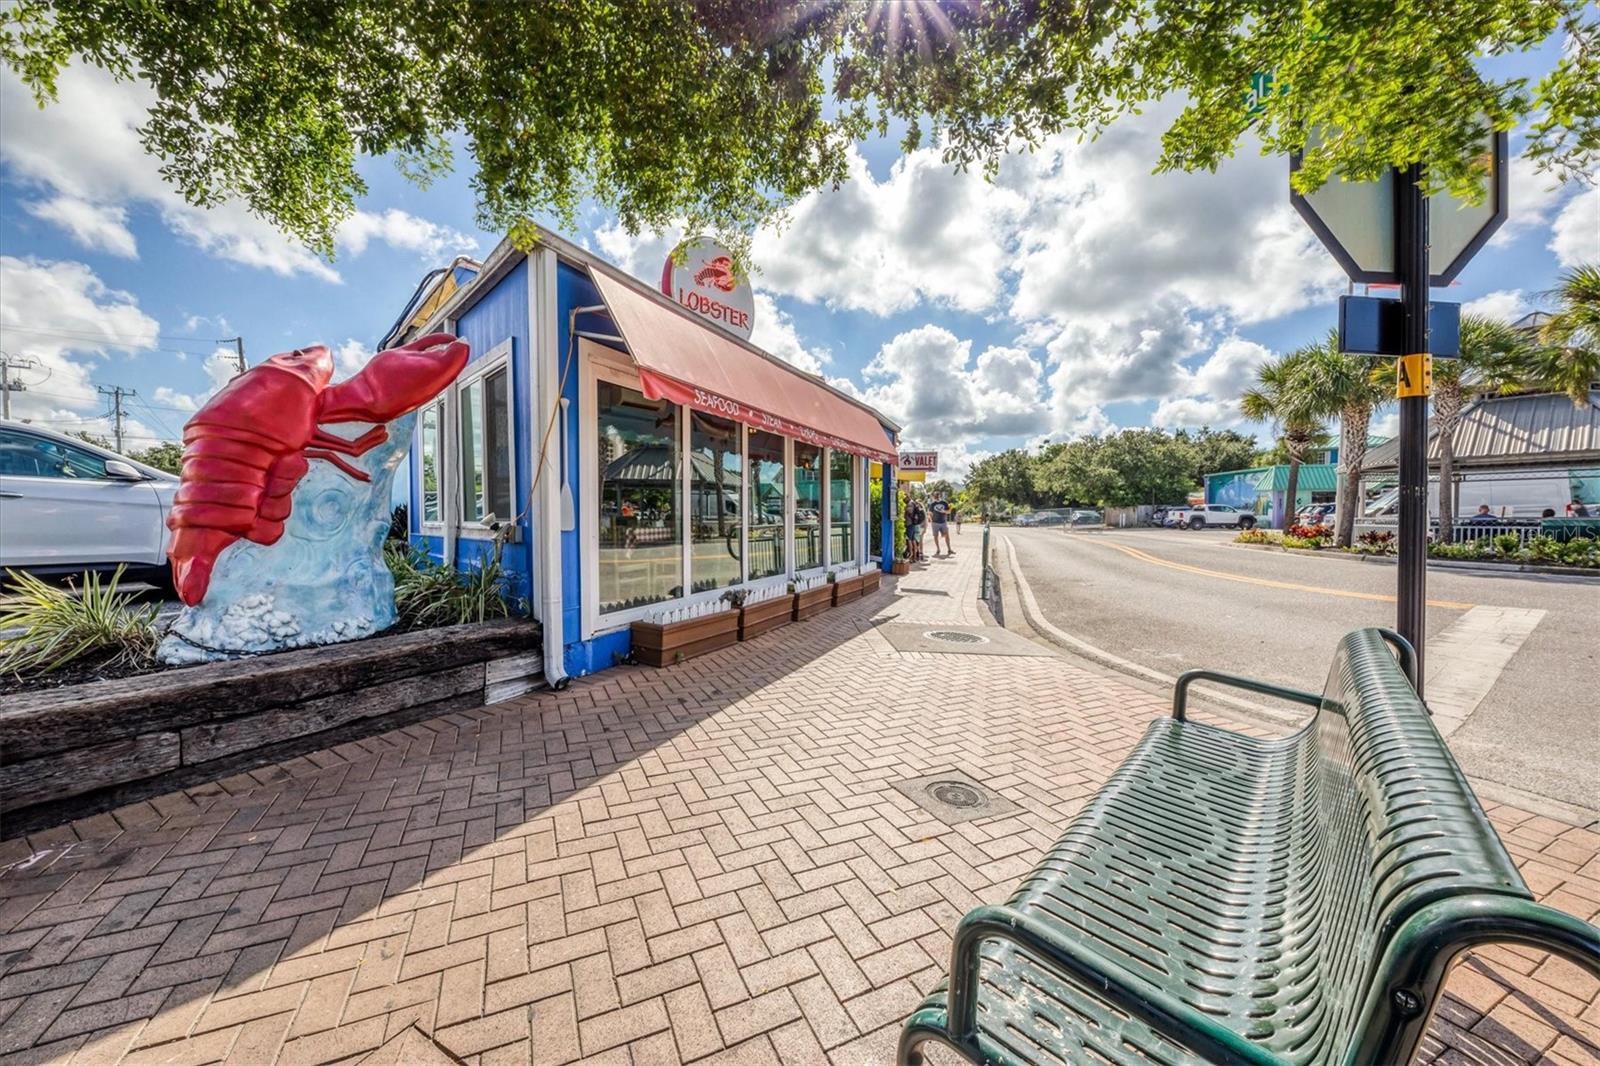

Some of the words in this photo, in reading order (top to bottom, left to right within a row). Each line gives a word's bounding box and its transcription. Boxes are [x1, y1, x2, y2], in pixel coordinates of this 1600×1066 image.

[679, 287, 750, 331] LOBSTER
[693, 388, 741, 416] SEAFOOD
[915, 454, 937, 467] VALET
